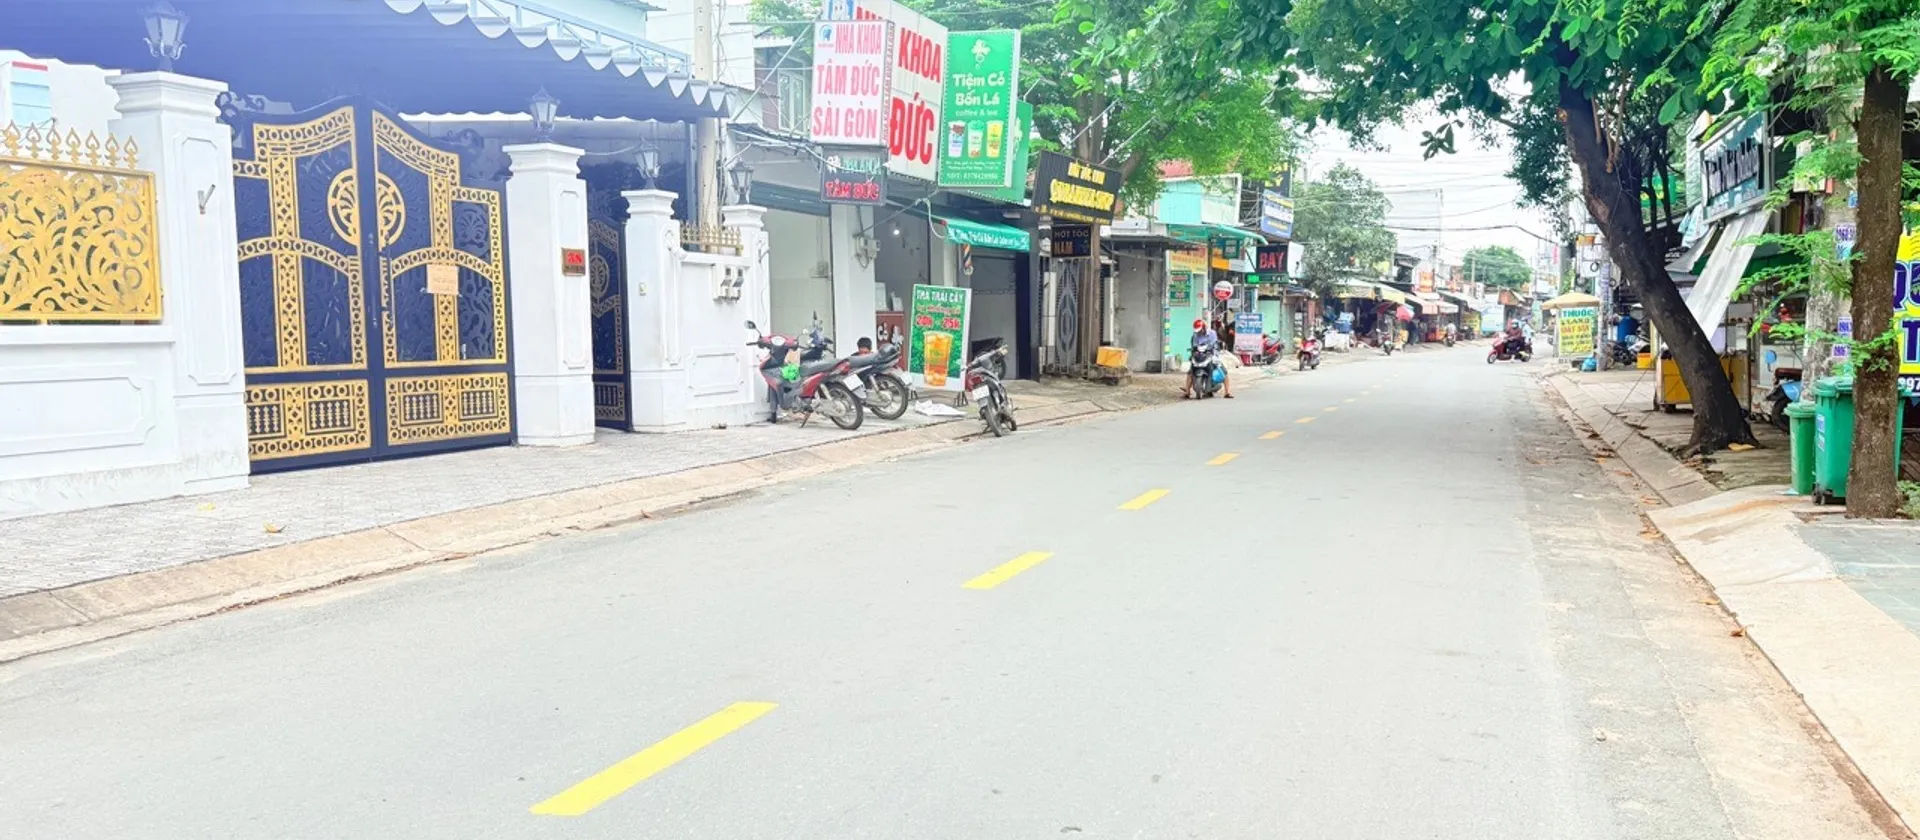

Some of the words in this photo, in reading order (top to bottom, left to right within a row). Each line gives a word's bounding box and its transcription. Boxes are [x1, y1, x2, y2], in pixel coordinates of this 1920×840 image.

[856, 24, 882, 55] KHOA
[898, 27, 942, 83] KHOA
[817, 58, 848, 95] TÂM
[851, 59, 880, 97] ĐỨC
[953, 72, 985, 89] Tiệm
[813, 100, 840, 136] SÀI
[844, 101, 878, 139] GÒN
[889, 92, 935, 164] ĐỨC
[1259, 251, 1286, 272] BAY
